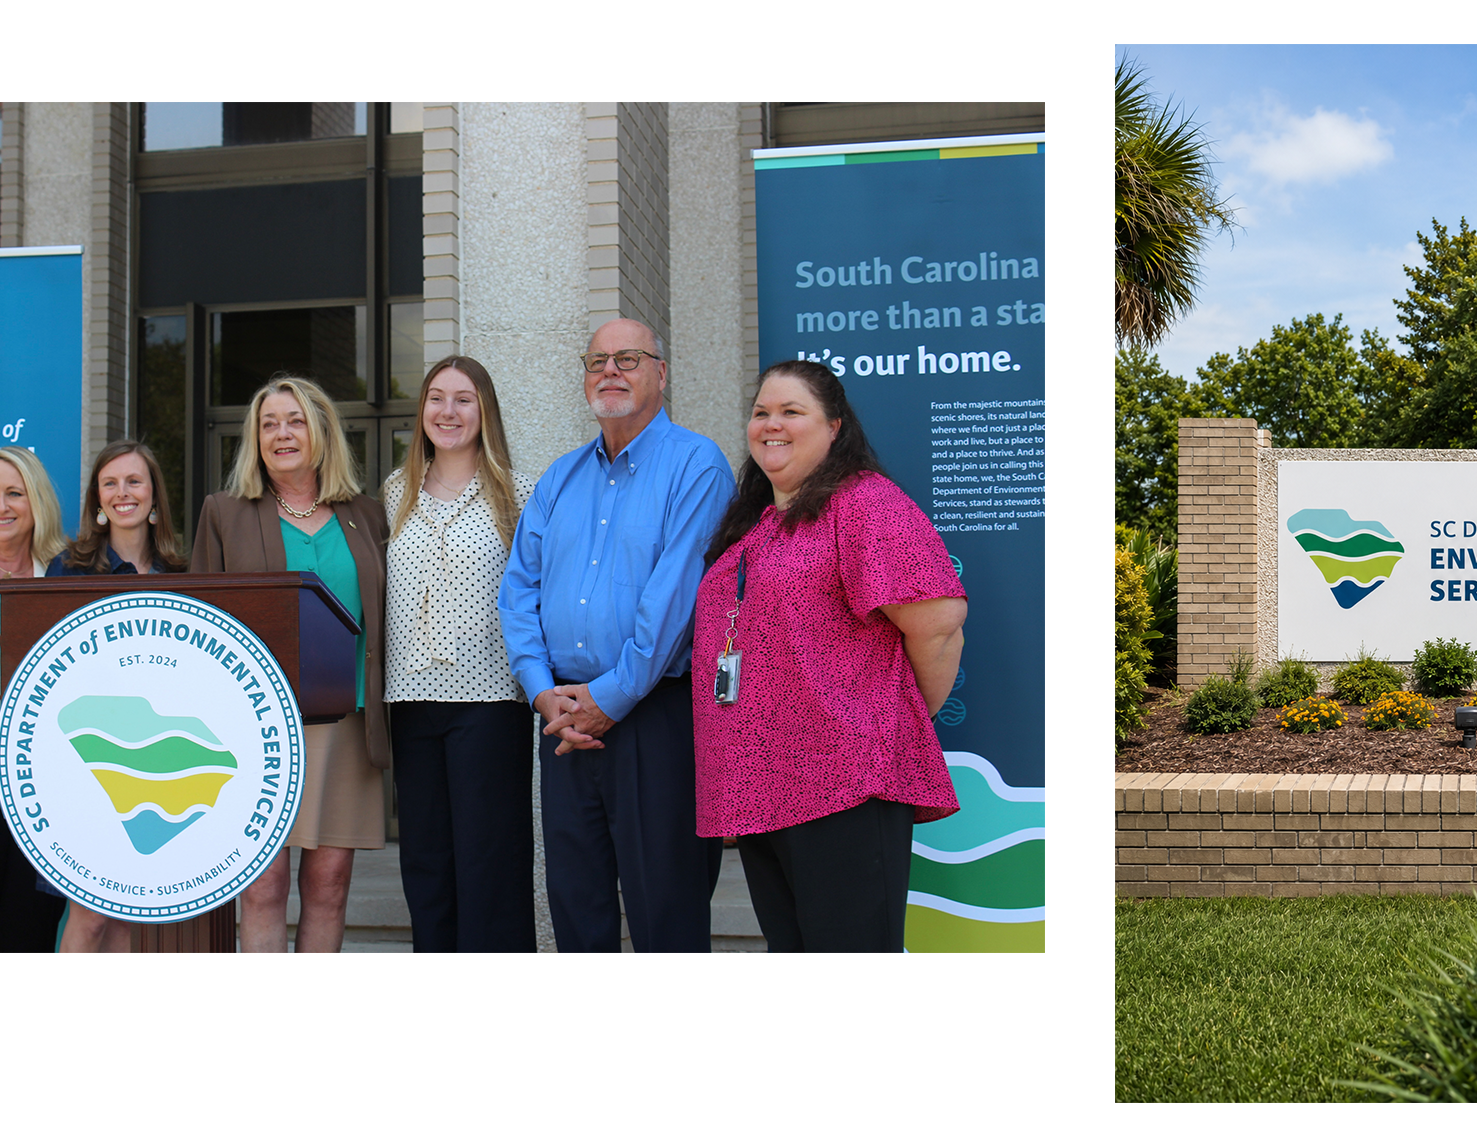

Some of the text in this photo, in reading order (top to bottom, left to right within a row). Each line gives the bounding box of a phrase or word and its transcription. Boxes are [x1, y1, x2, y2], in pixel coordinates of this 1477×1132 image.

[795, 251, 1039, 288] South Carolina
[796, 300, 1045, 333] more than a sta
[853, 353, 910, 377] our
[917, 345, 1021, 375] home.
[931, 401, 952, 410] From
[953, 401, 967, 409] the
[969, 400, 1002, 410] majestic
[931, 414, 956, 422] scenic
[957, 413, 986, 421] shores,
[987, 412, 997, 420] its
[999, 411, 1028, 420] natural
[2, 418, 25, 443] of
[931, 426, 957, 434] where
[971, 424, 988, 433] find
[990, 425, 1004, 433] not
[1005, 424, 1021, 434] just
[931, 438, 952, 446] work
[953, 437, 969, 445] and
[970, 437, 987, 446] live,
[988, 437, 1003, 445] but
[1011, 436, 1033, 446] place
[1034, 436, 1044, 444] to
[931, 450, 948, 458] and
[955, 450, 978, 460] place
[989, 449, 1015, 457] thrive.
[1016, 448, 1034, 456] And
[932, 462, 961, 472] people
[961, 462, 978, 472] join
[999, 461, 1027, 470] calling
[1028, 460, 1044, 468] this
[932, 475, 953, 483] state
[953, 474, 980, 483] home,
[996, 473, 1011, 481] the
[1012, 472, 1037, 481] South
[932, 487, 983, 497] Department
[983, 486, 993, 494] of
[932, 499, 968, 508] Services,
[969, 498, 993, 507] stand
[1004, 497, 1041, 506] stewards
[939, 511, 964, 520] clean,
[965, 510, 998, 519] resilient
[998, 510, 1015, 519] and
[934, 522, 1020, 532] South Carolina for all.
[1430, 521, 1456, 538] SC
[119, 654, 178, 668] EST. 2024
[16, 618, 281, 842] SC DEPARTMENT of ENVIRONMENTAL SERVICES
[49, 841, 243, 896] SCIENCE SERVICE SUSTAINABILITY
